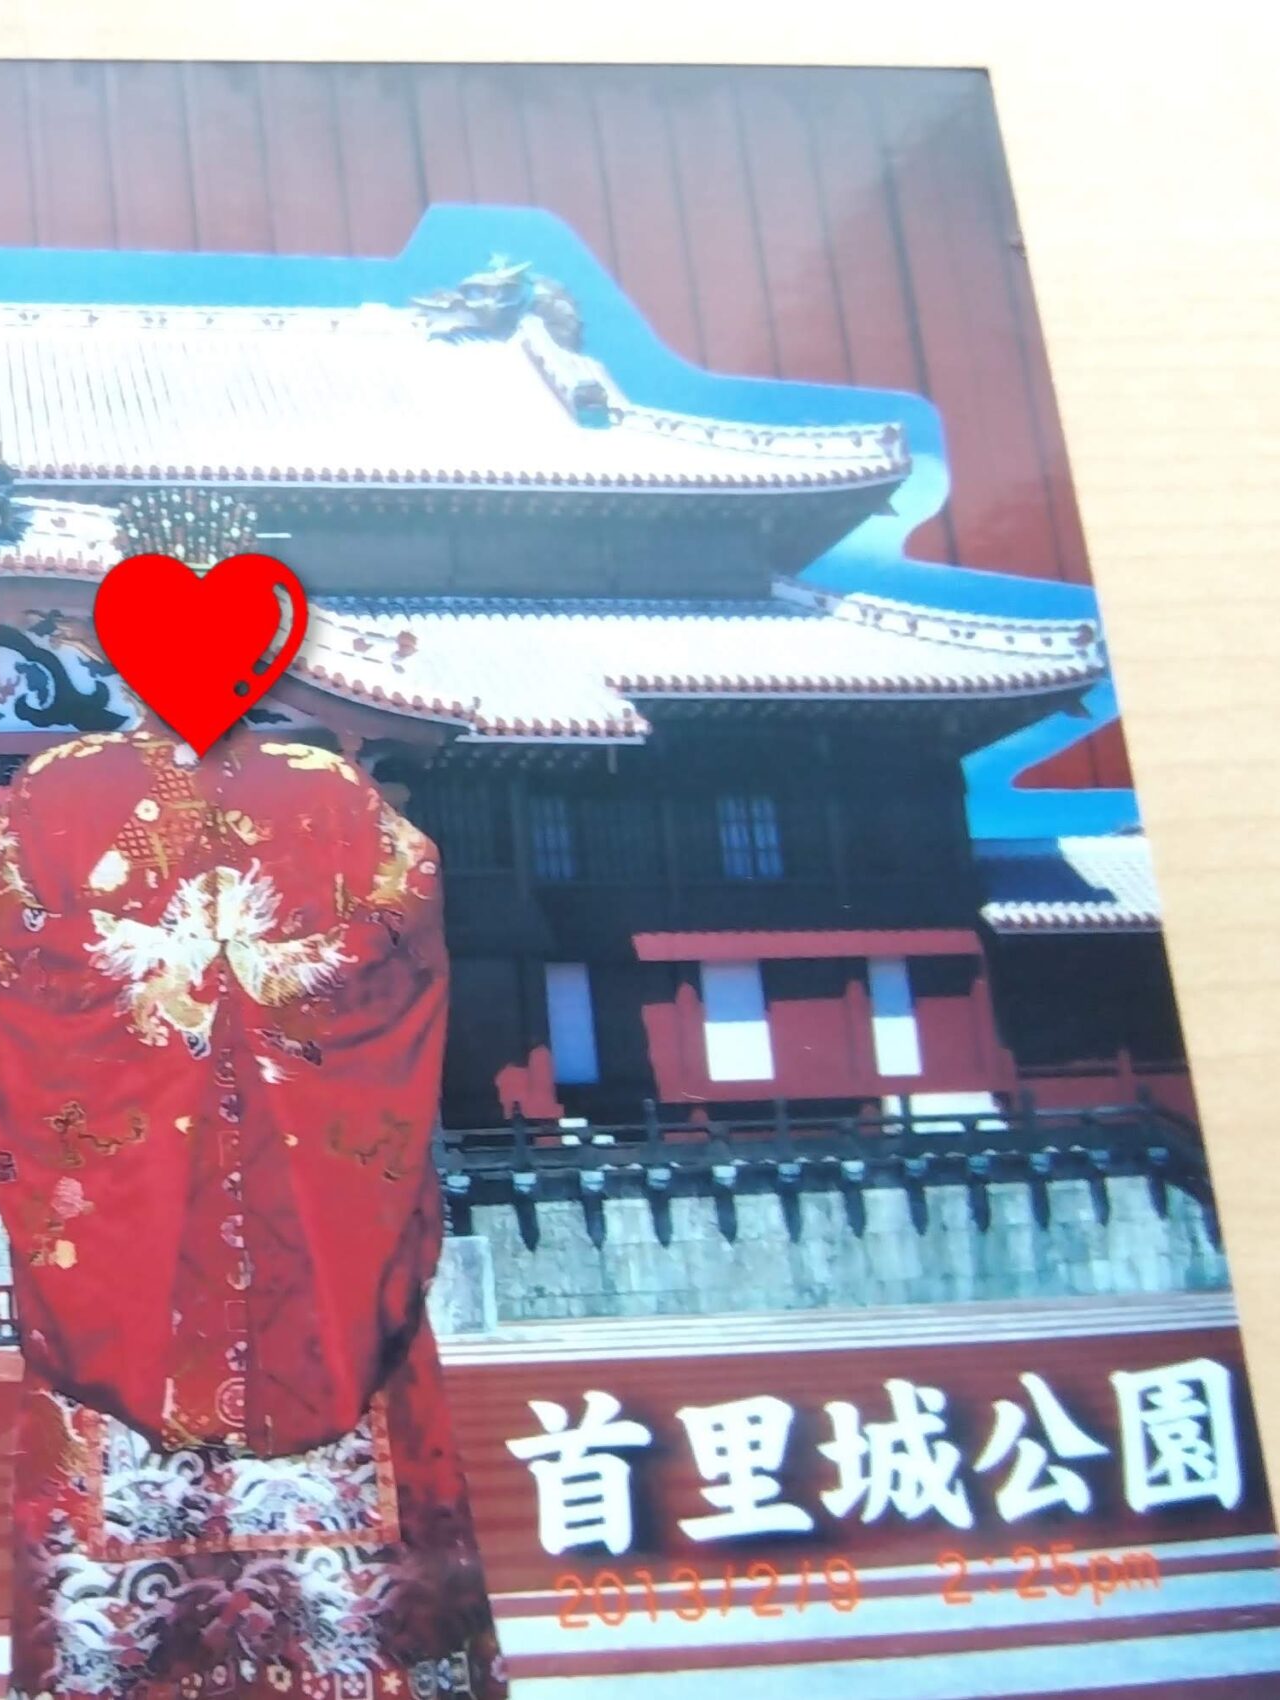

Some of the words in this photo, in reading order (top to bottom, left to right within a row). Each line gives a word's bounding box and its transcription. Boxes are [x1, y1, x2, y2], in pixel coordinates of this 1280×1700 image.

[506, 1357, 1244, 1556] 首里城公園
